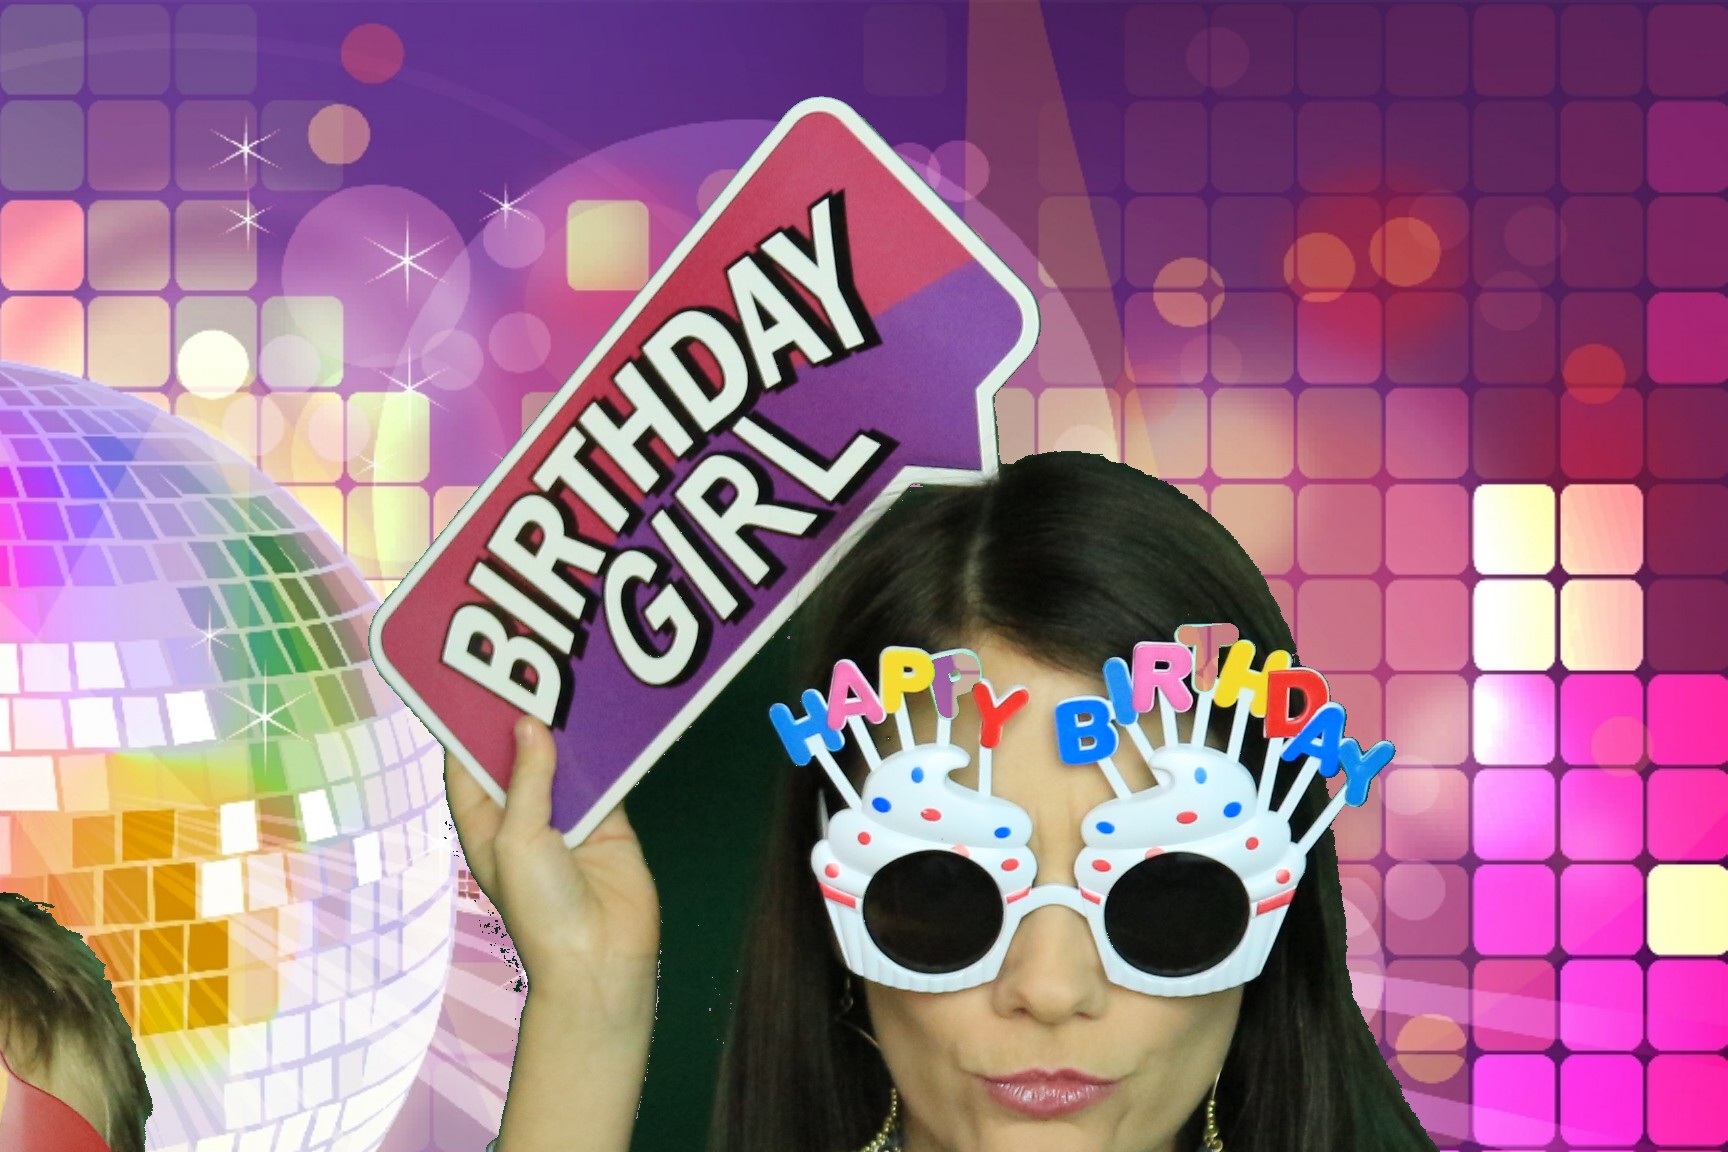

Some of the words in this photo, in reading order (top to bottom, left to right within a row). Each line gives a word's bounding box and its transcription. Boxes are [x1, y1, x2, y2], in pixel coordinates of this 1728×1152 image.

[441, 191, 882, 728] BIRTHDAY
[603, 415, 898, 688] GIRL
[769, 645, 1029, 767] HAPPY
[1054, 622, 1395, 807] BIRTHDAY
